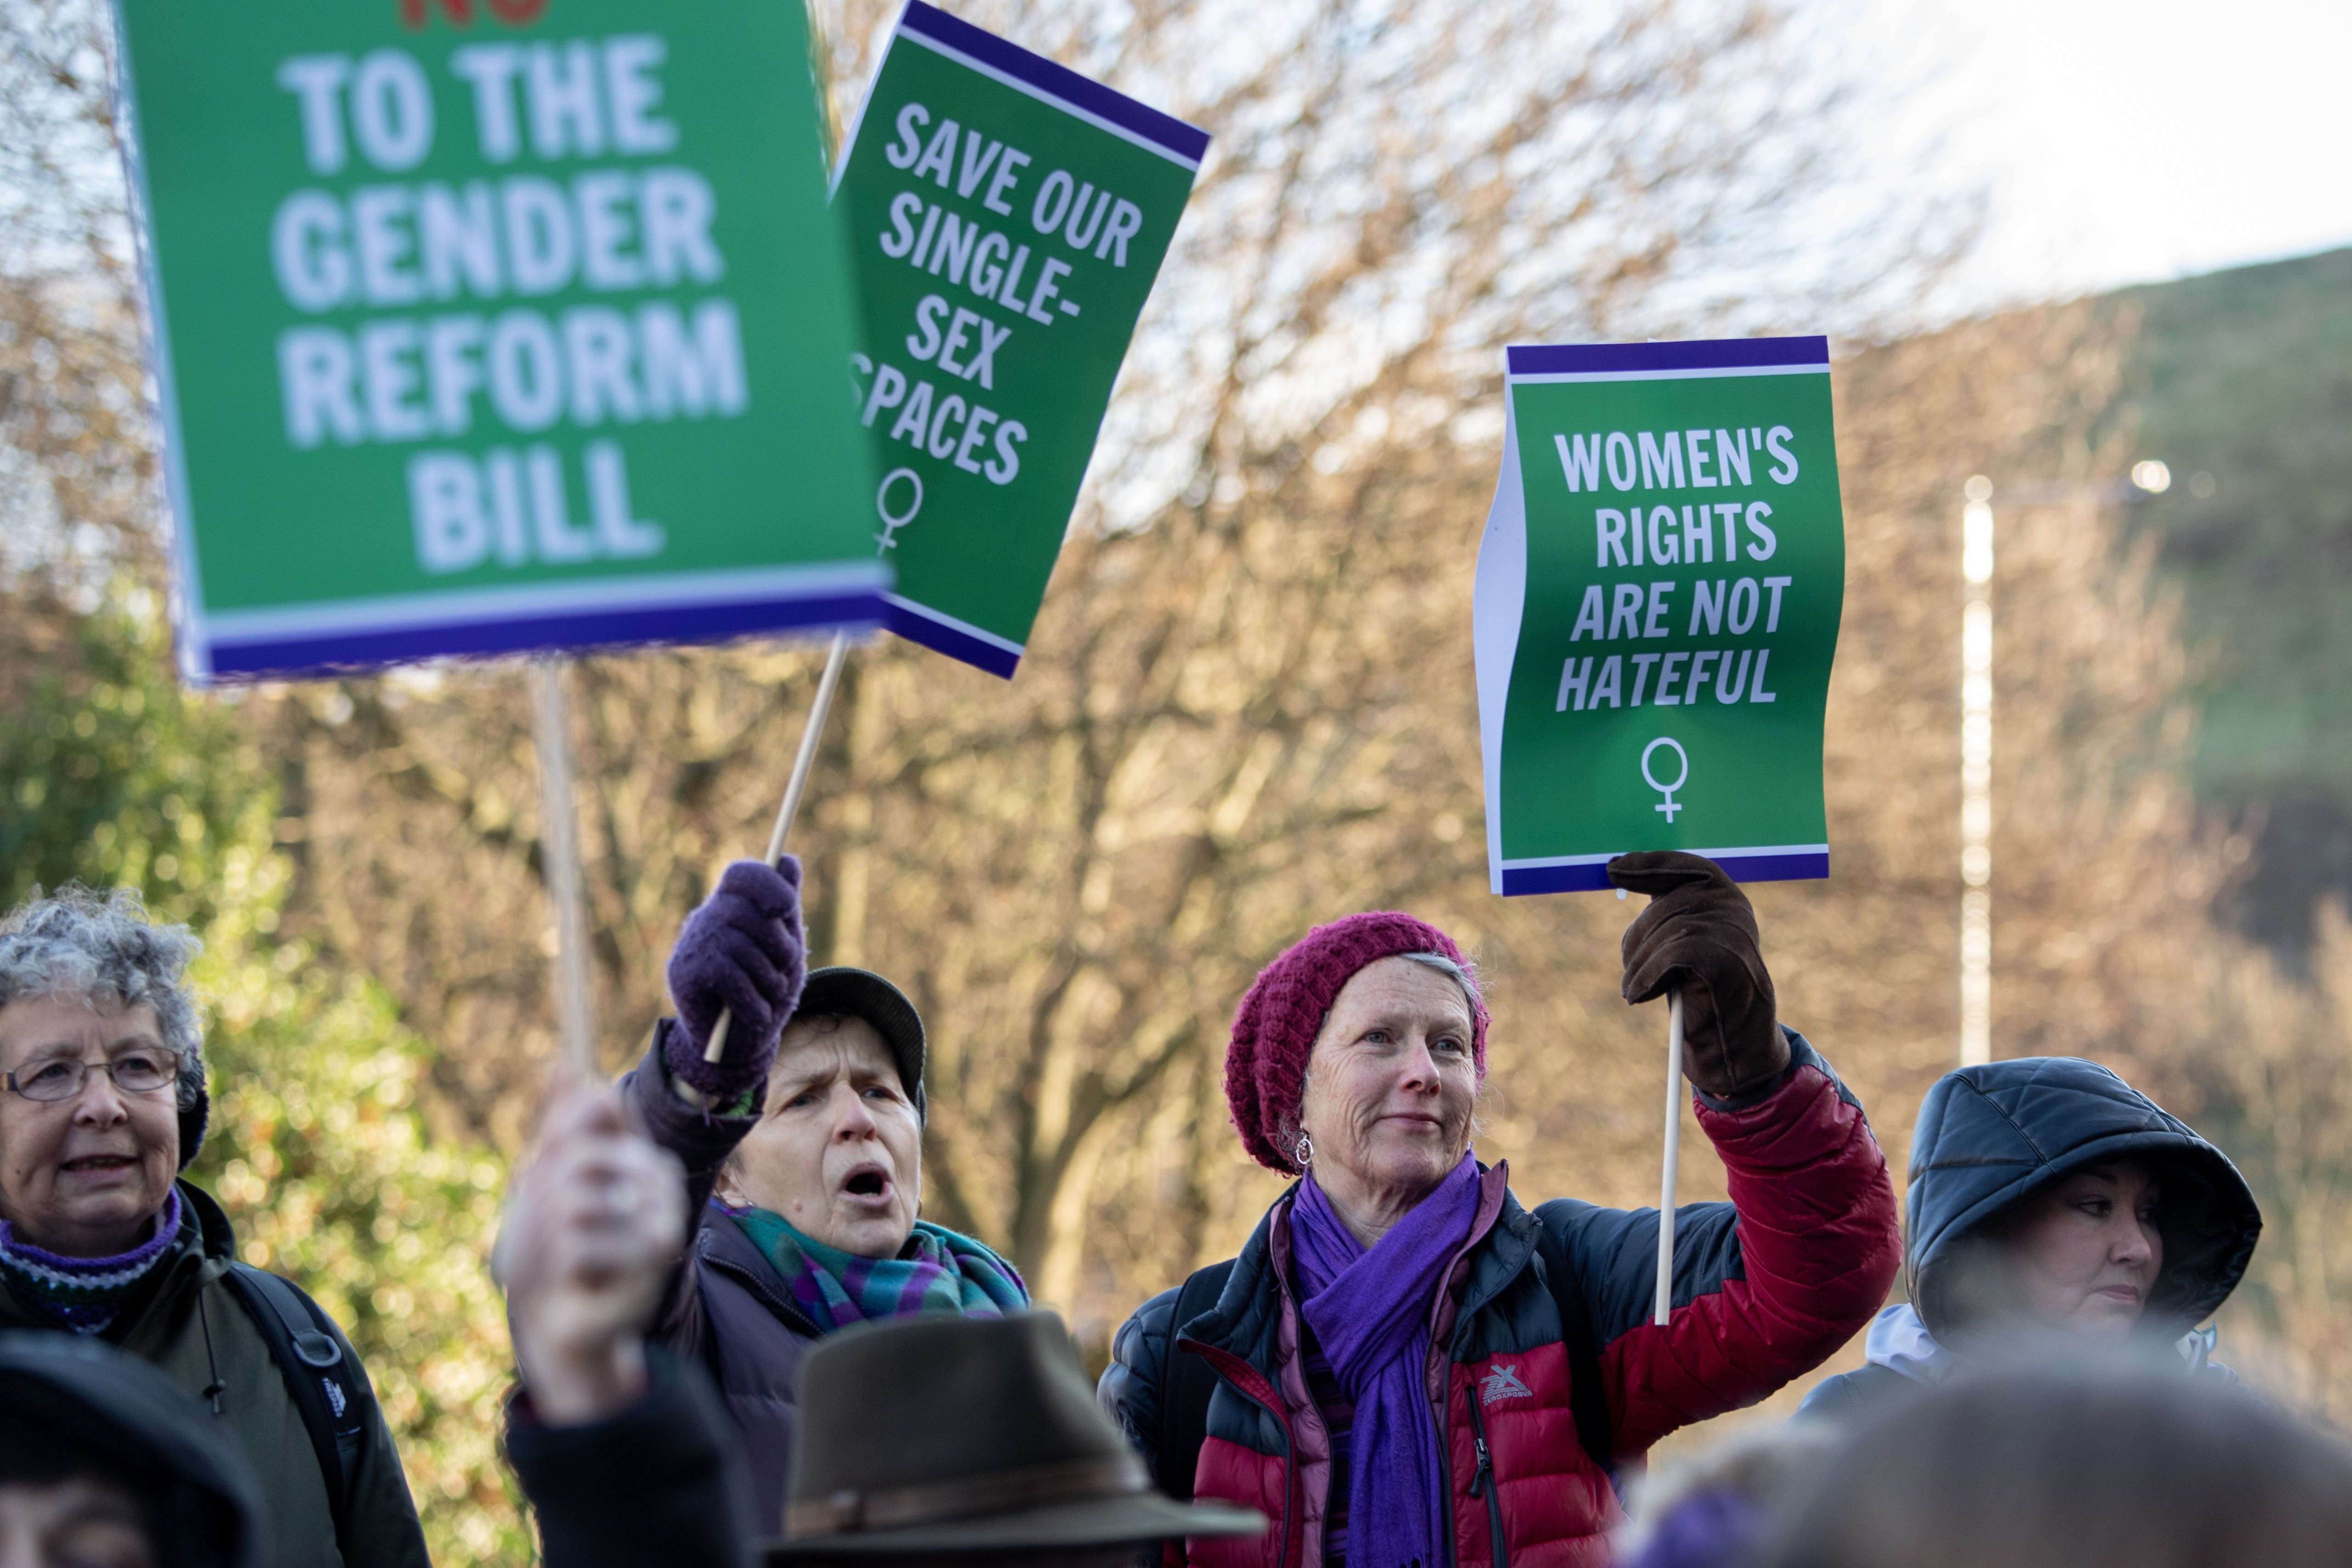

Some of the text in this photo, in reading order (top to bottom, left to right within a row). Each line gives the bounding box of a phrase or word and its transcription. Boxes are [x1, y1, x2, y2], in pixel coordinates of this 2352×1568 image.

[279, 35, 676, 173] TO THE
[271, 166, 723, 312] GENDER
[885, 102, 1143, 268] SAVE OUR
[879, 191, 1081, 326] SINGLE-
[278, 299, 748, 447] REFORM
[906, 294, 1012, 390] SEX
[407, 441, 665, 574] BILL
[1553, 425, 1800, 493] WOMEN'S
[1595, 500, 1778, 568] RIGHTS
[1570, 575, 1793, 642] ARE NOT
[1555, 648, 1777, 712] HATEFUL
